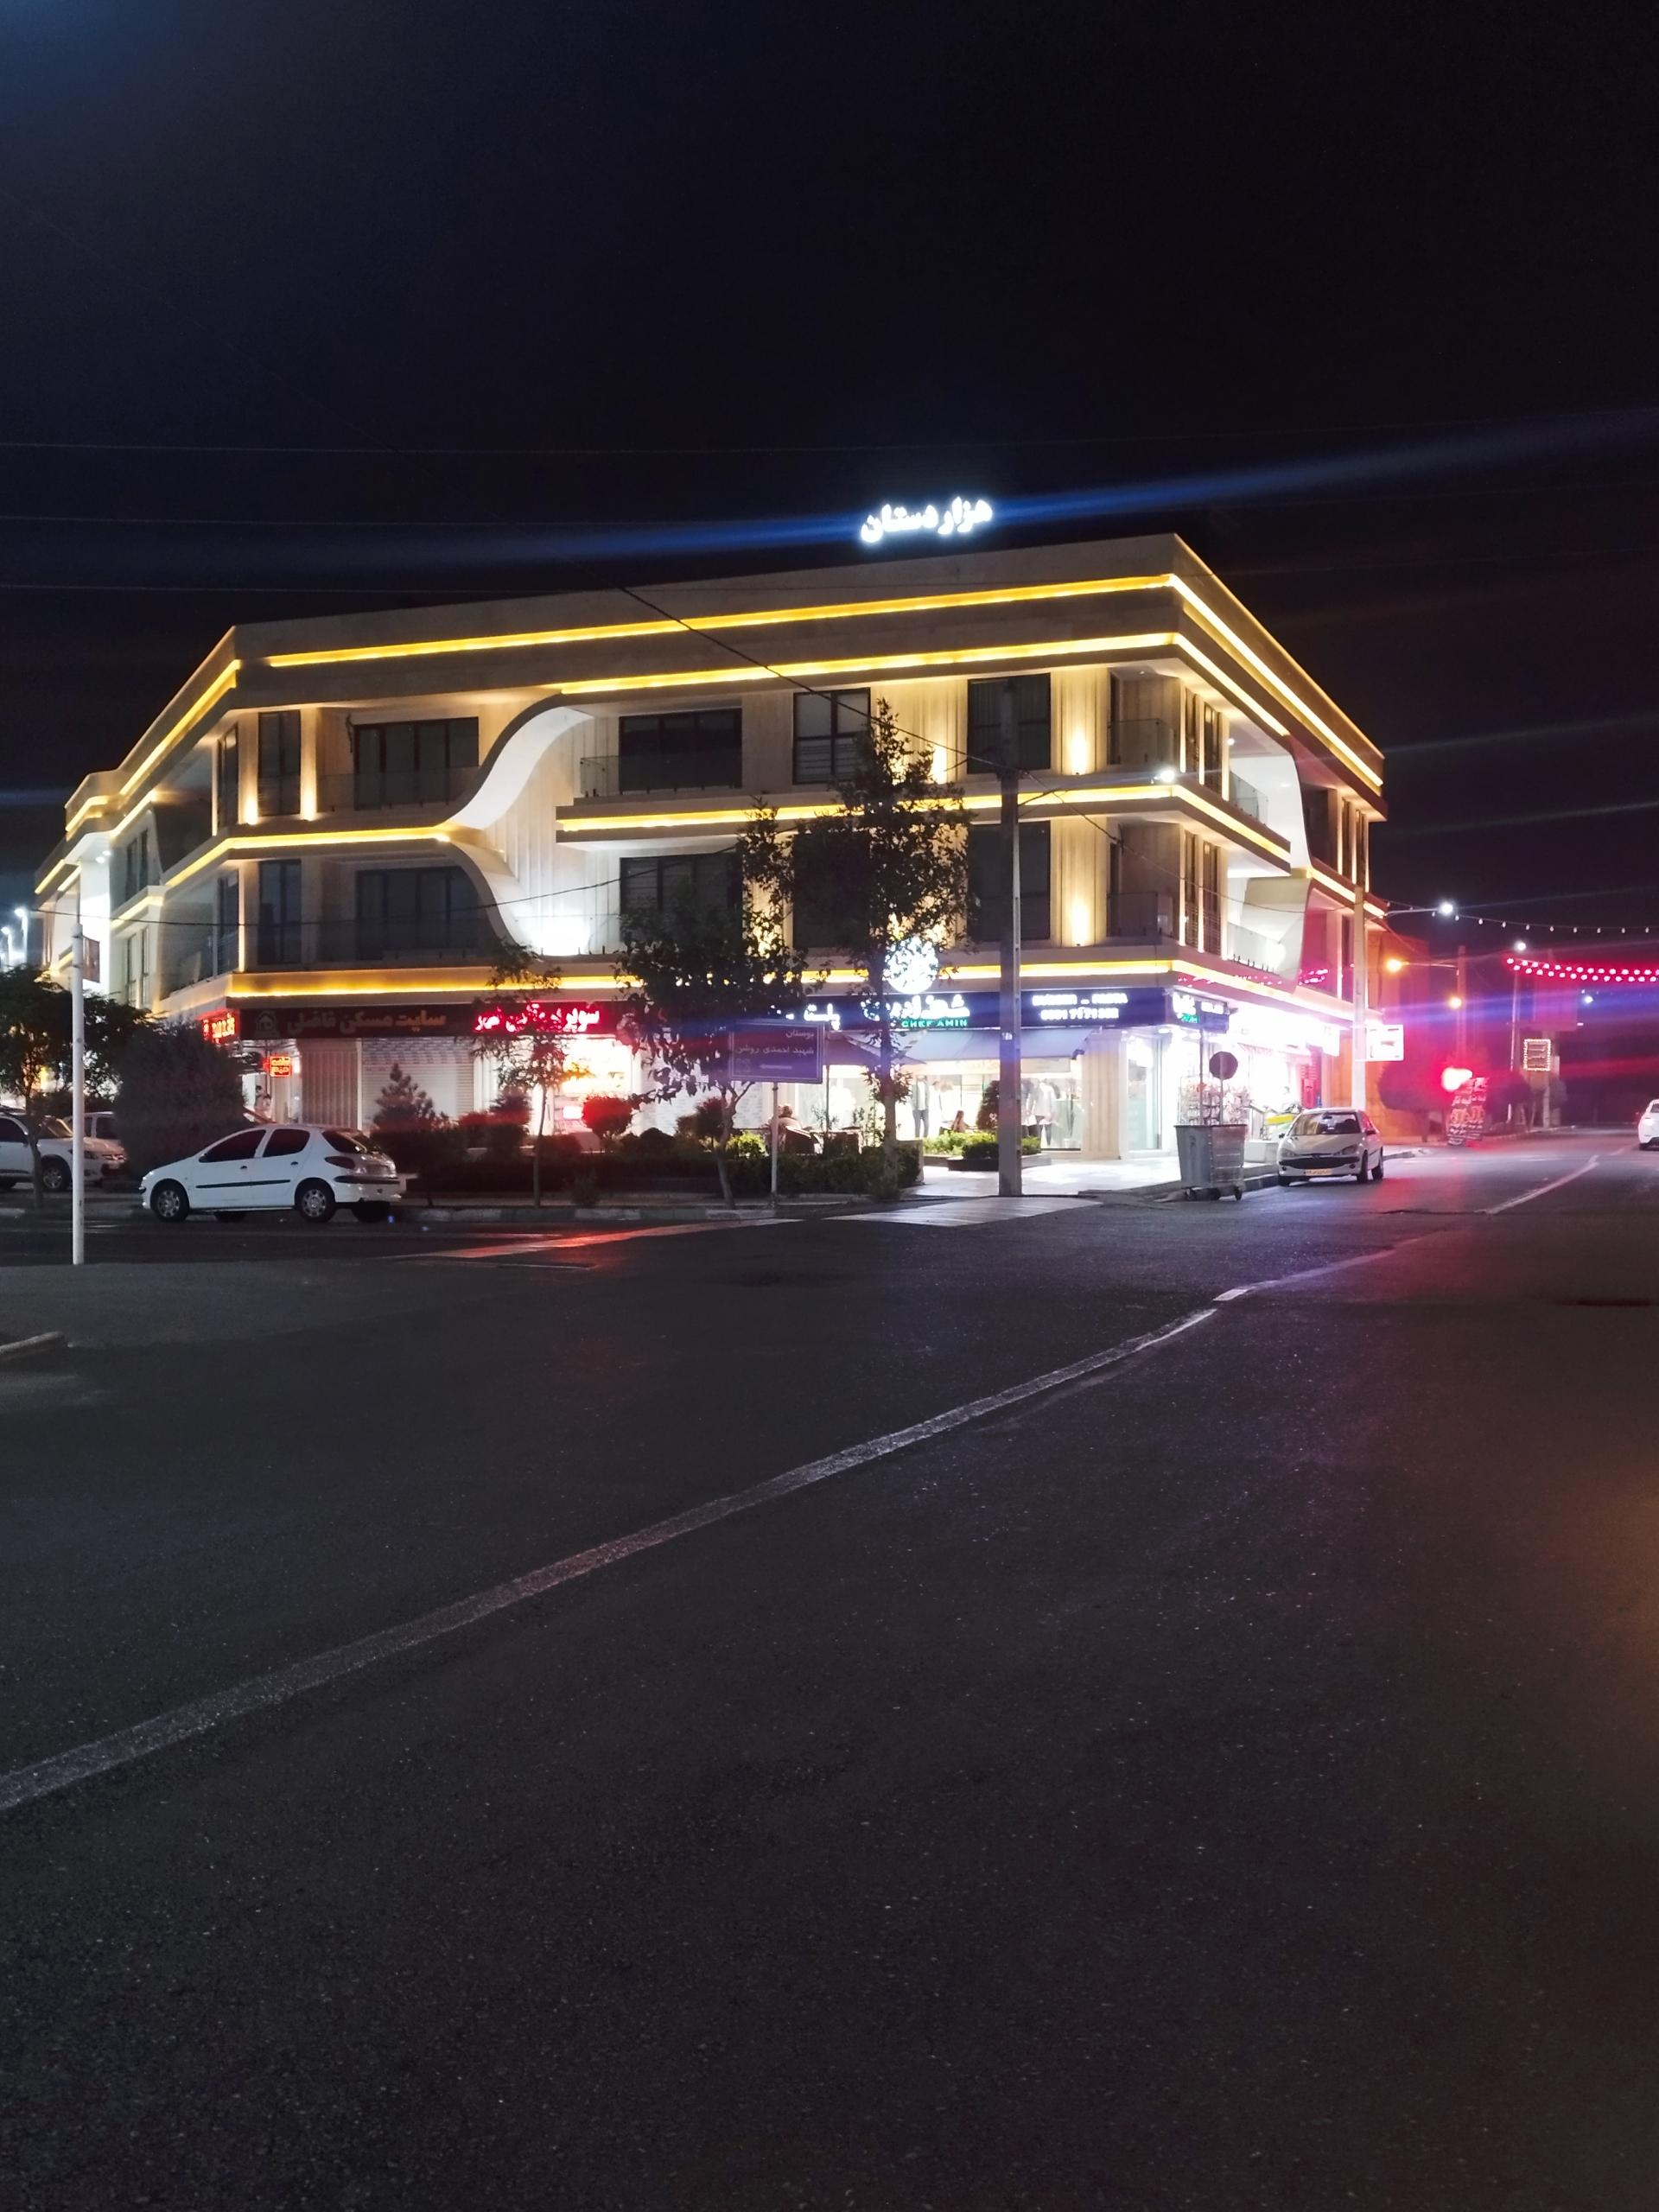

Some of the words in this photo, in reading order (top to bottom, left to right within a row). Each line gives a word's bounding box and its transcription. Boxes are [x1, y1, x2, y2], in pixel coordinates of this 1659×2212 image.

[340, 1011, 394, 1034] مسکن
[901, 1020, 933, 1028] CHEF
[936, 1018, 969, 1027] AMIN
[785, 1029, 815, 1039] بوستان
[762, 1046, 790, 1055] احمدی
[792, 1046, 815, 1057] شهید
